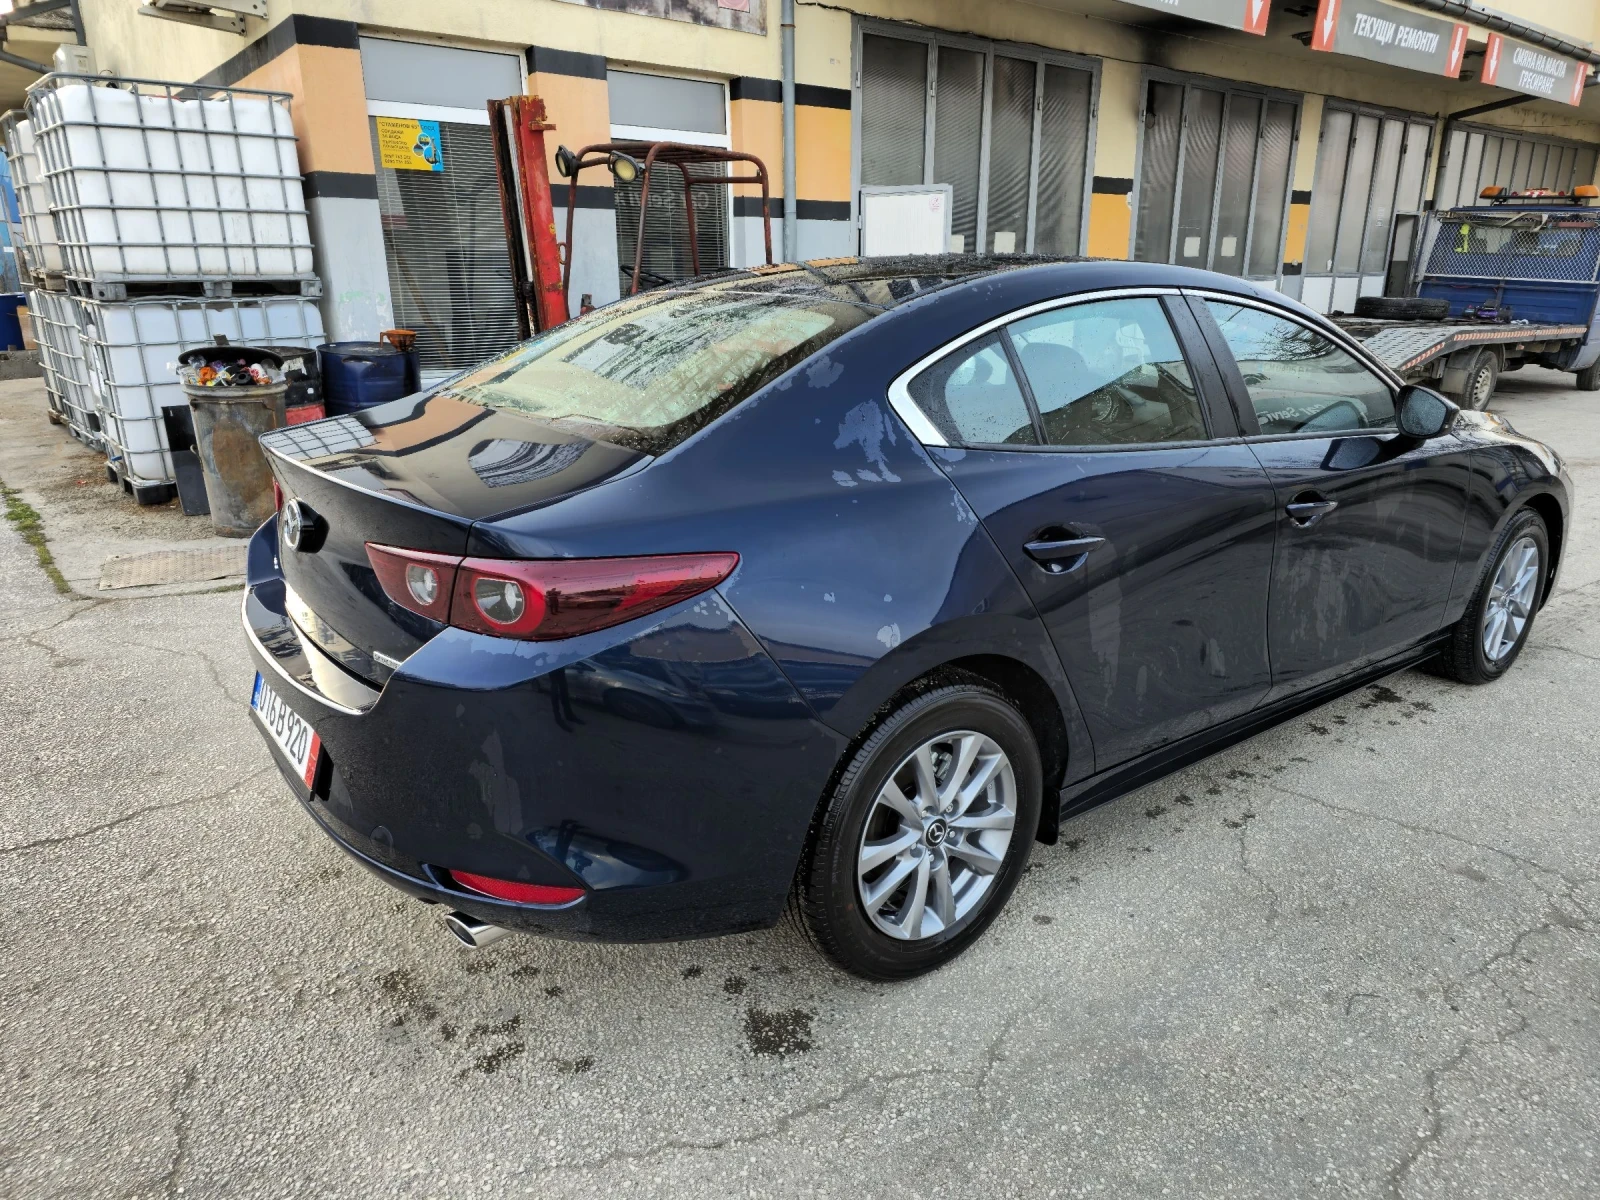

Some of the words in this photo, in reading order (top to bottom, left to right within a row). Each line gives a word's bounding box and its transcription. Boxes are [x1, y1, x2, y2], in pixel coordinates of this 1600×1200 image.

[1353, 13, 1396, 45] ТЕКУЩИ
[1394, 25, 1440, 54] РЕМОНТИ
[1513, 47, 1537, 69] СМЯНА
[1535, 54, 1547, 72] НА
[1544, 56, 1567, 78] МАСЛА
[1518, 70, 1555, 94] ГРЕСИРАНЕ
